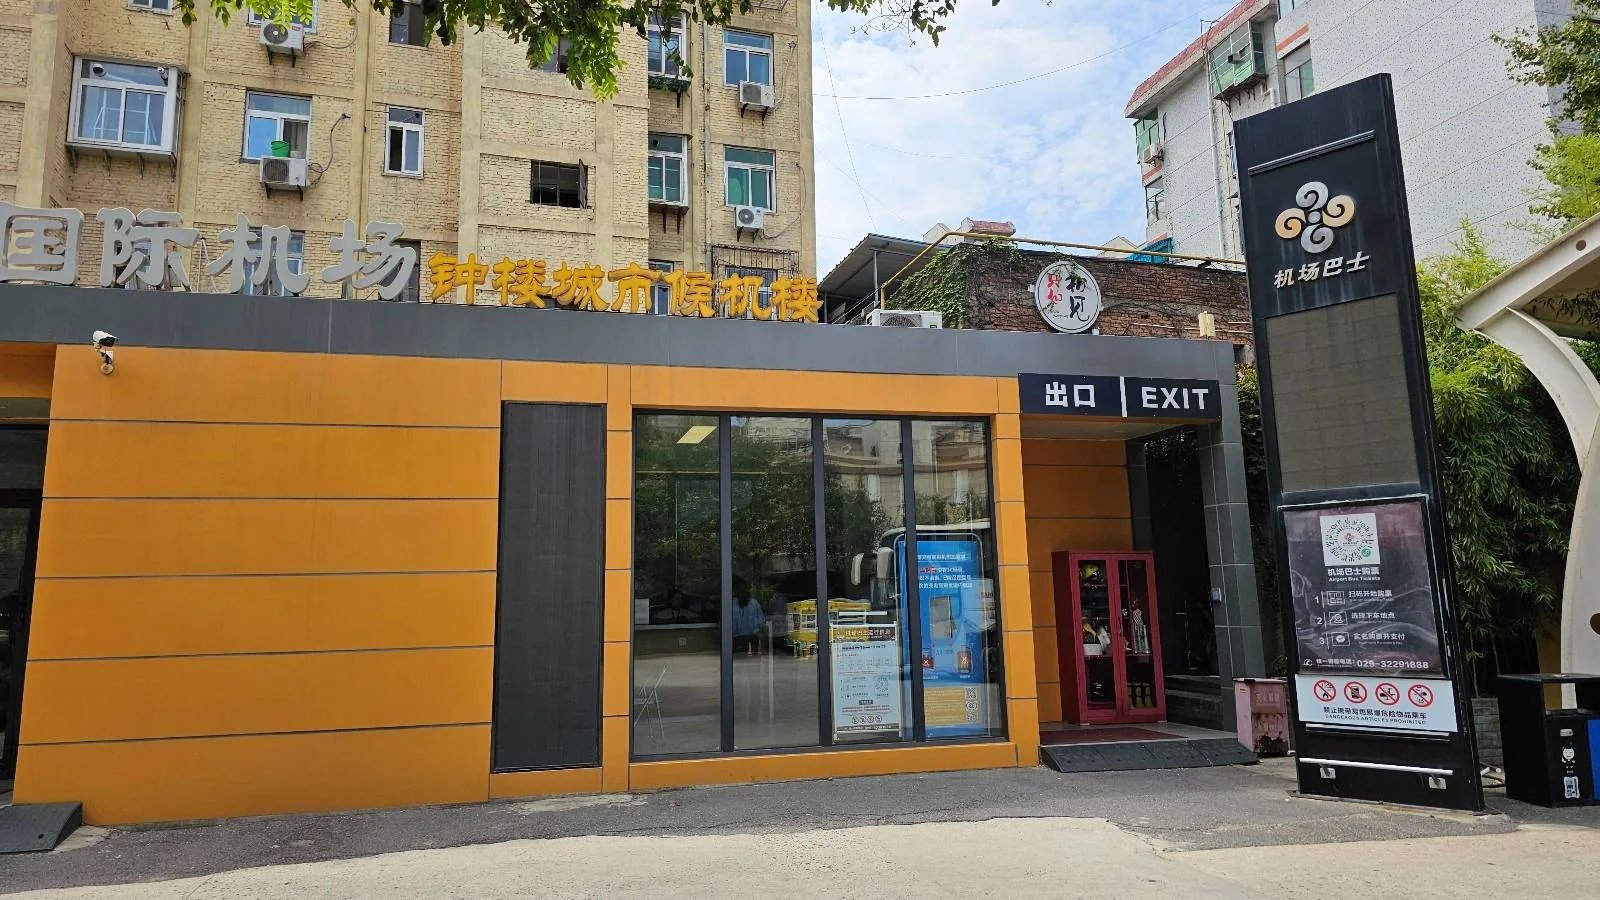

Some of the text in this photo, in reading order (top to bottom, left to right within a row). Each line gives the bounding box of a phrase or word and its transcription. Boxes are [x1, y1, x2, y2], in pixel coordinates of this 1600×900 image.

[0, 202, 417, 301] 国际机场
[1273, 251, 1370, 288] 机场巴士
[427, 251, 824, 323] 钟楼城市候机楼
[1045, 381, 1096, 408] 出口
[1141, 386, 1209, 410] EXIT
[1328, 567, 1380, 576] 机场巴士购票
[1348, 589, 1393, 598] 扫码开始购票
[1314, 596, 1320, 604] 1
[1316, 616, 1323, 625] 2
[1319, 637, 1325, 645] 3
[1356, 660, 1429, 669] 029-32291888
